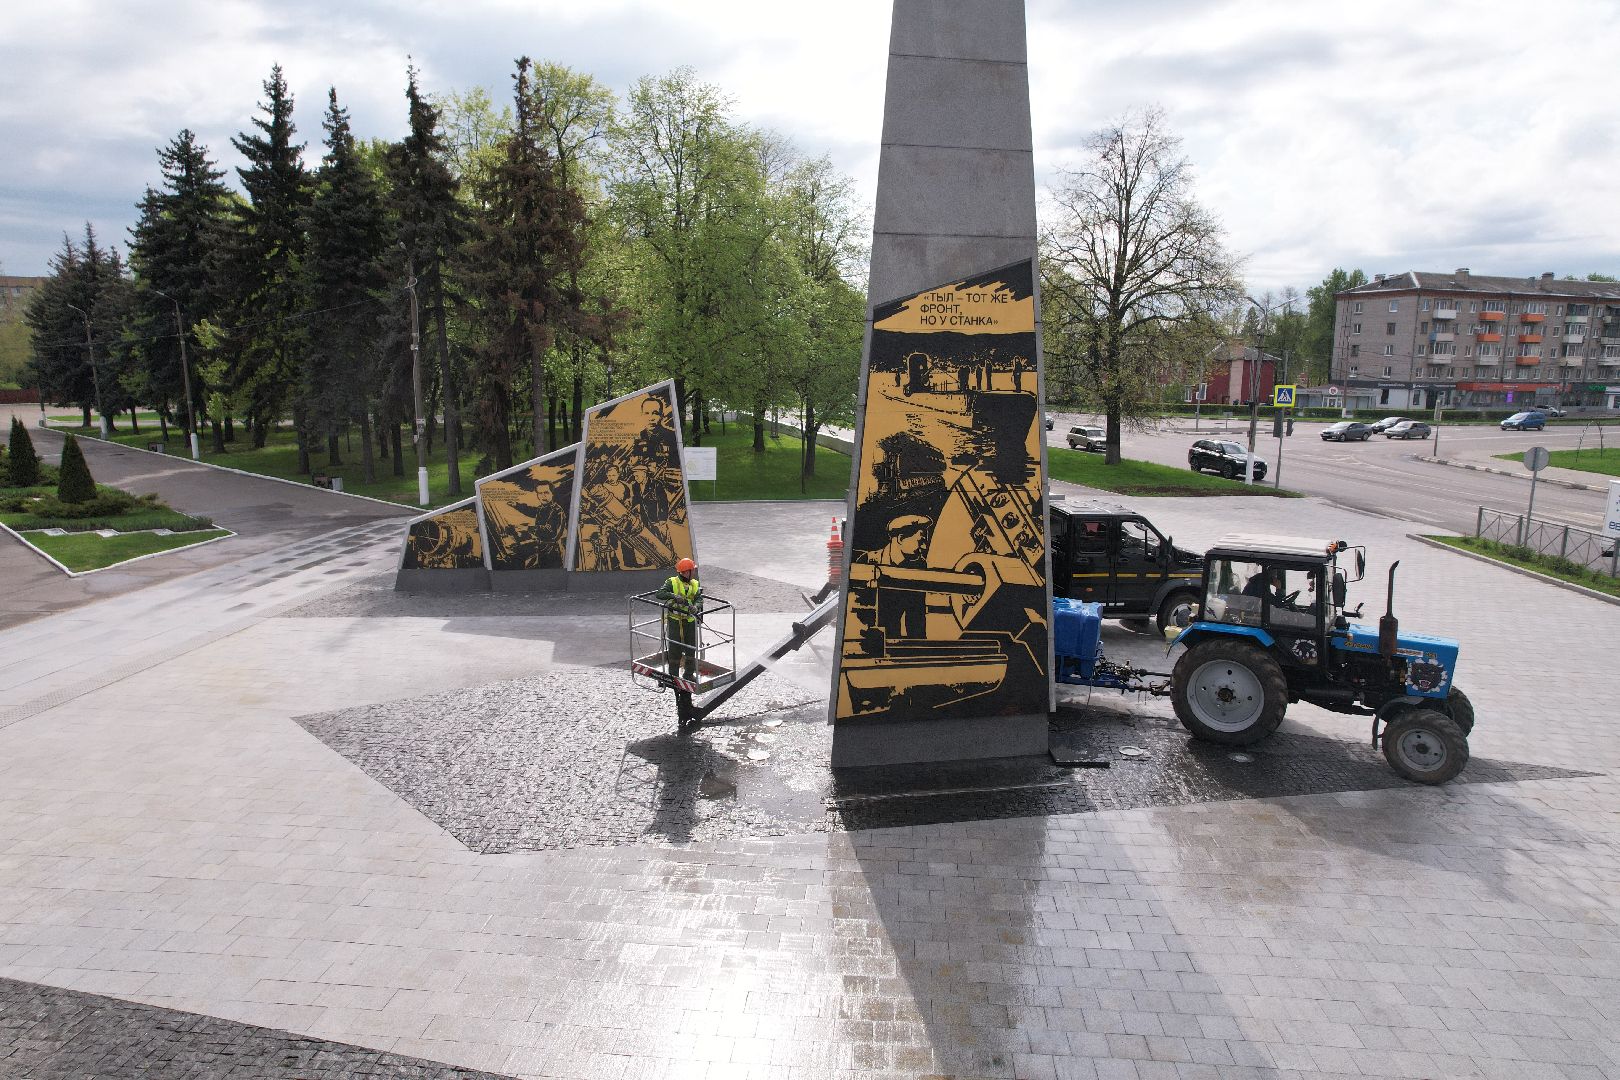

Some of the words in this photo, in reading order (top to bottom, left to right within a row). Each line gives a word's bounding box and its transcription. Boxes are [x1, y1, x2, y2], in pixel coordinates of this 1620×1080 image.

[924, 293, 954, 302] «ТЫЛ
[966, 293, 987, 302] ТОТ
[990, 294, 1008, 303] ЖЕ
[920, 304, 962, 315] ФРОНТ,
[920, 316, 936, 325] НО
[940, 316, 948, 325] У
